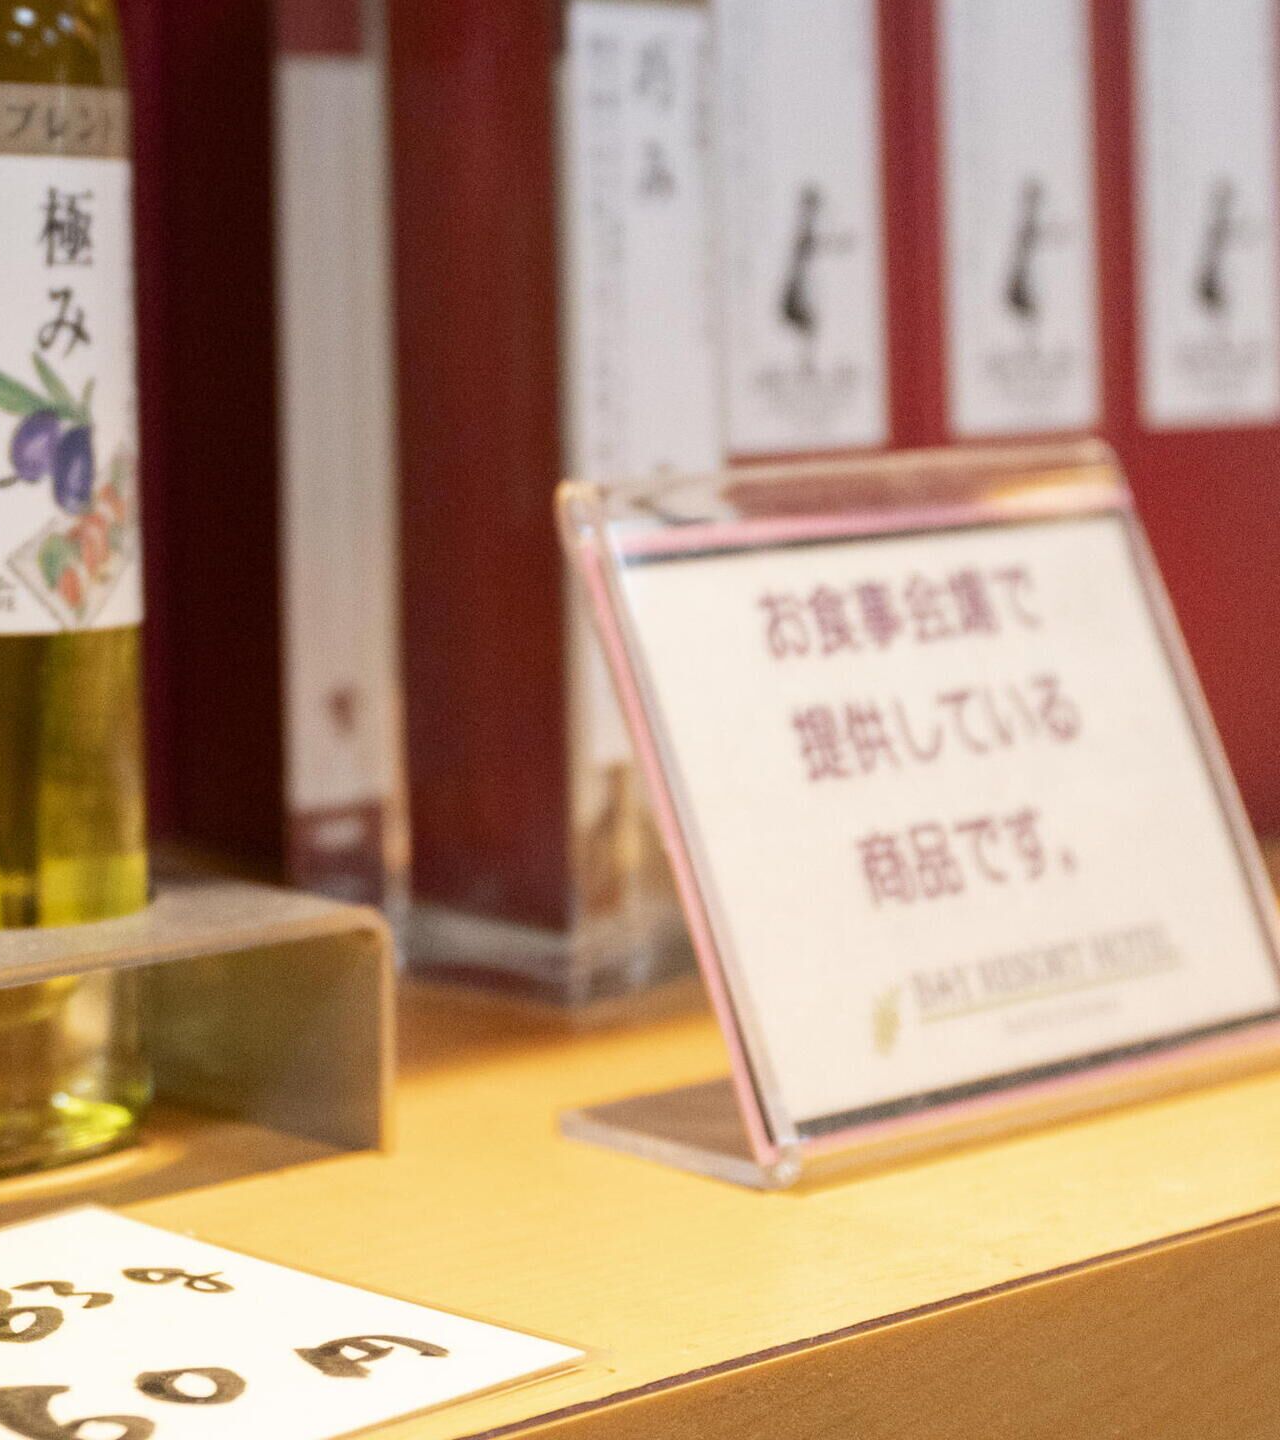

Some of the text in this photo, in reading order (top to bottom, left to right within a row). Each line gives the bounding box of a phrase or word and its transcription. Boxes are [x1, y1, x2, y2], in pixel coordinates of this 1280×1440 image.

[38, 185, 94, 359] 極み
[760, 568, 1042, 660] お食事会場で
[793, 675, 1083, 784] 提供している
